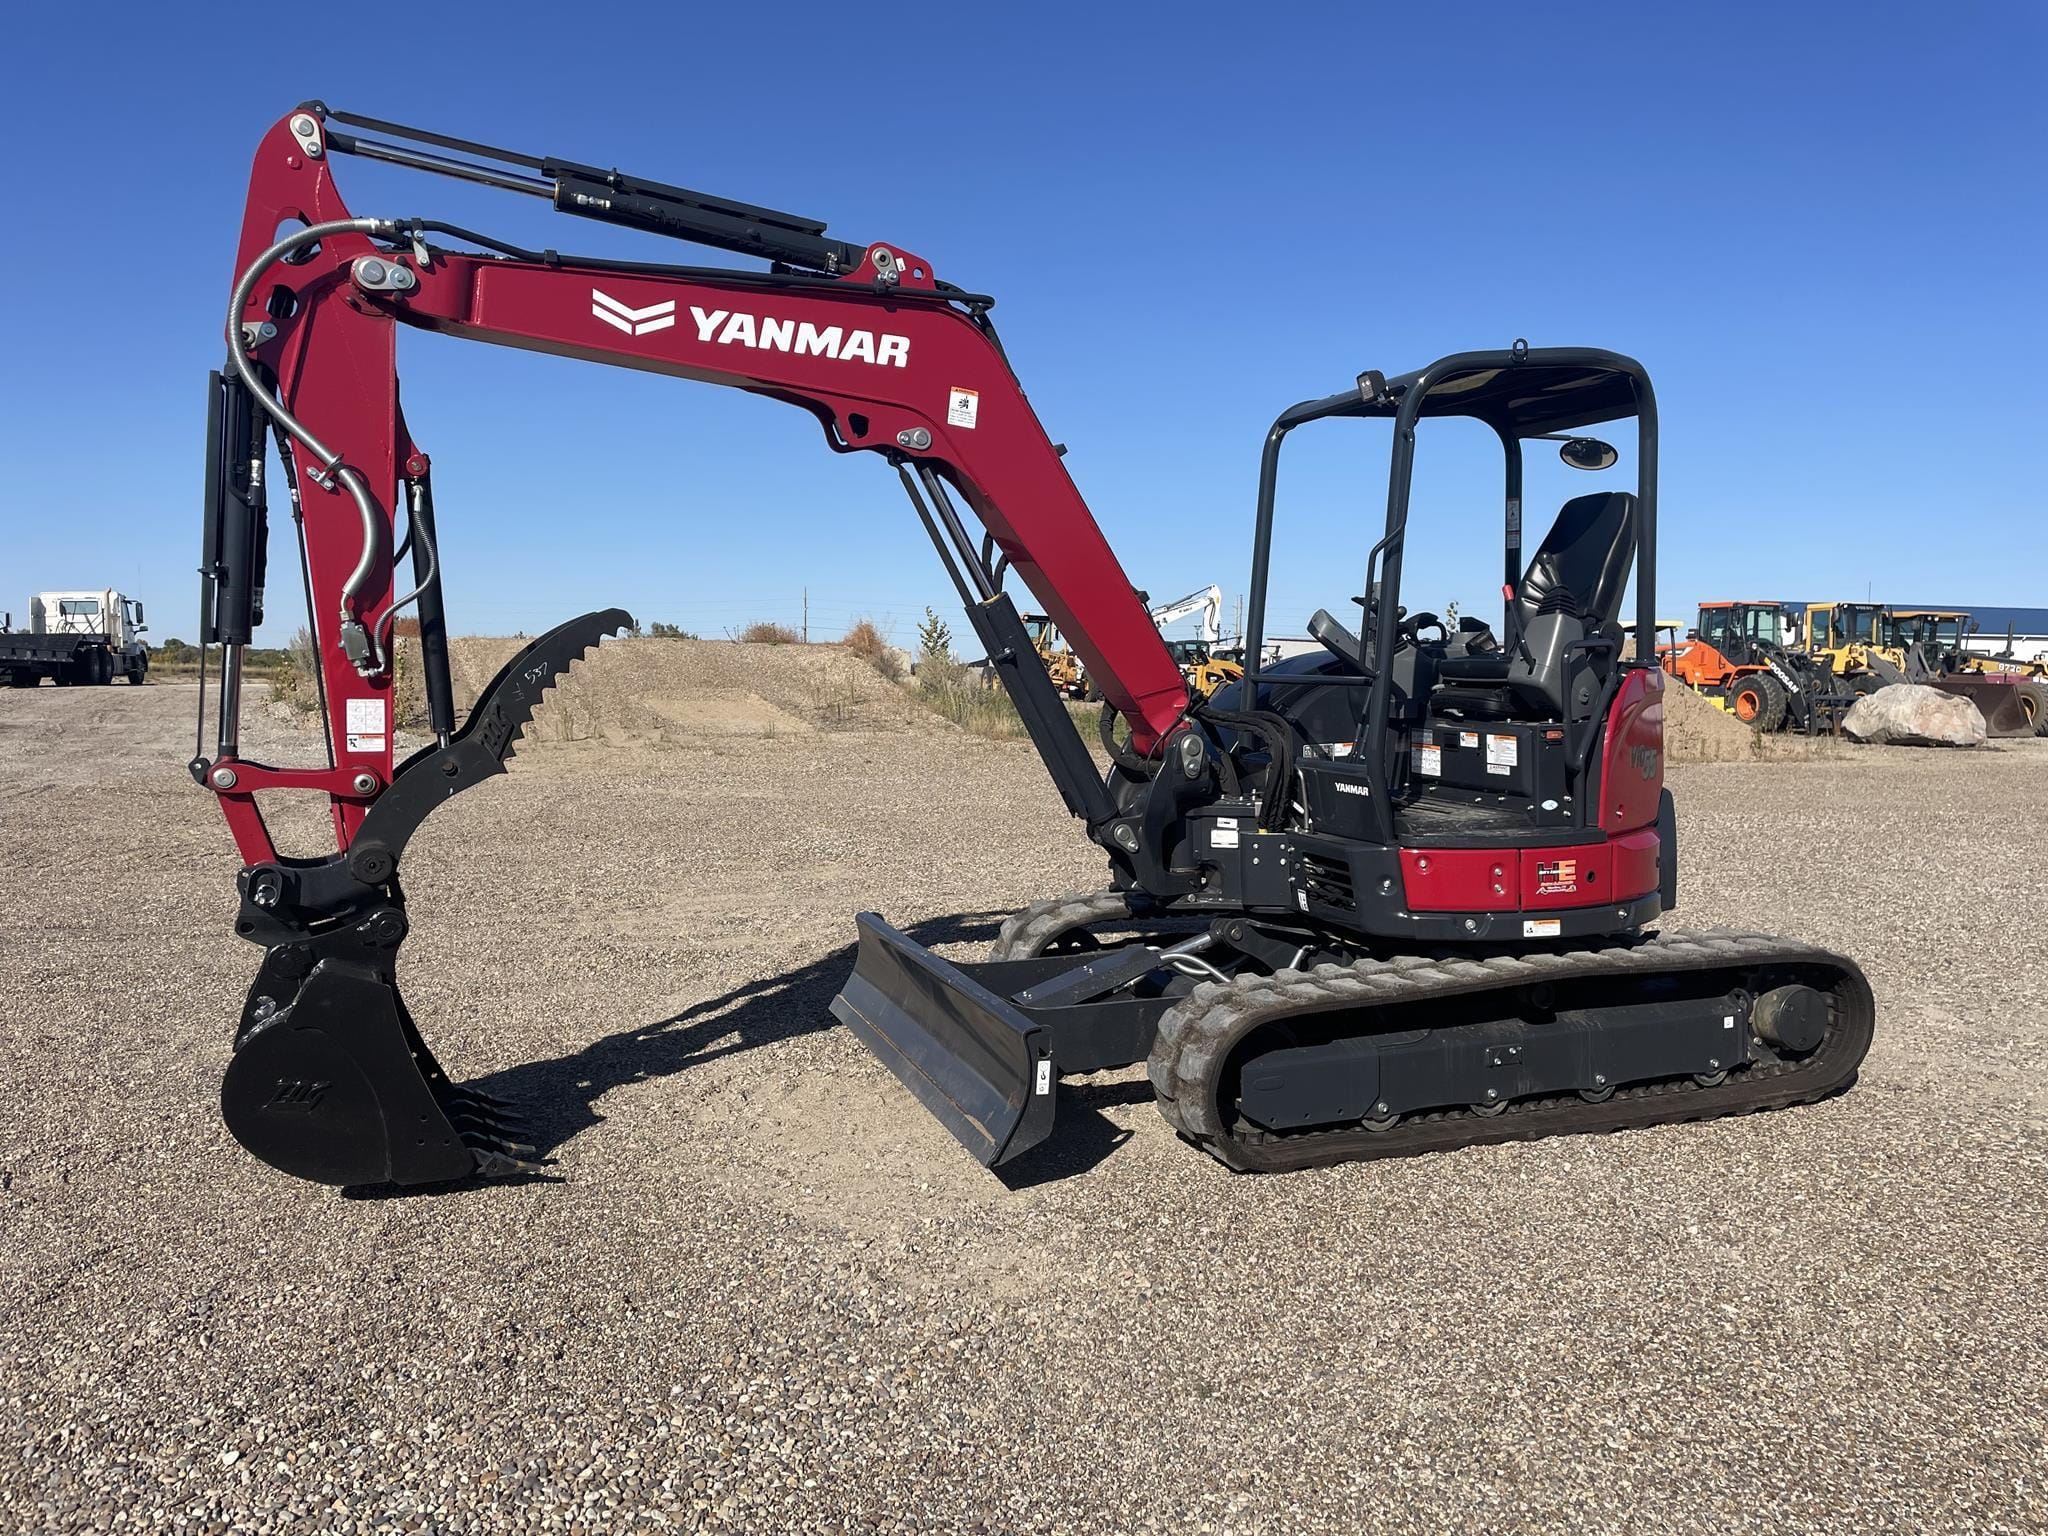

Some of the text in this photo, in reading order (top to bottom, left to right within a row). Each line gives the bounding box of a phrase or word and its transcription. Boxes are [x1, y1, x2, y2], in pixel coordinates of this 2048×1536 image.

[689, 306, 911, 368] YANMAR
[1769, 662, 1800, 694] DOOSAN
[1335, 782, 1369, 797] YANMAR
